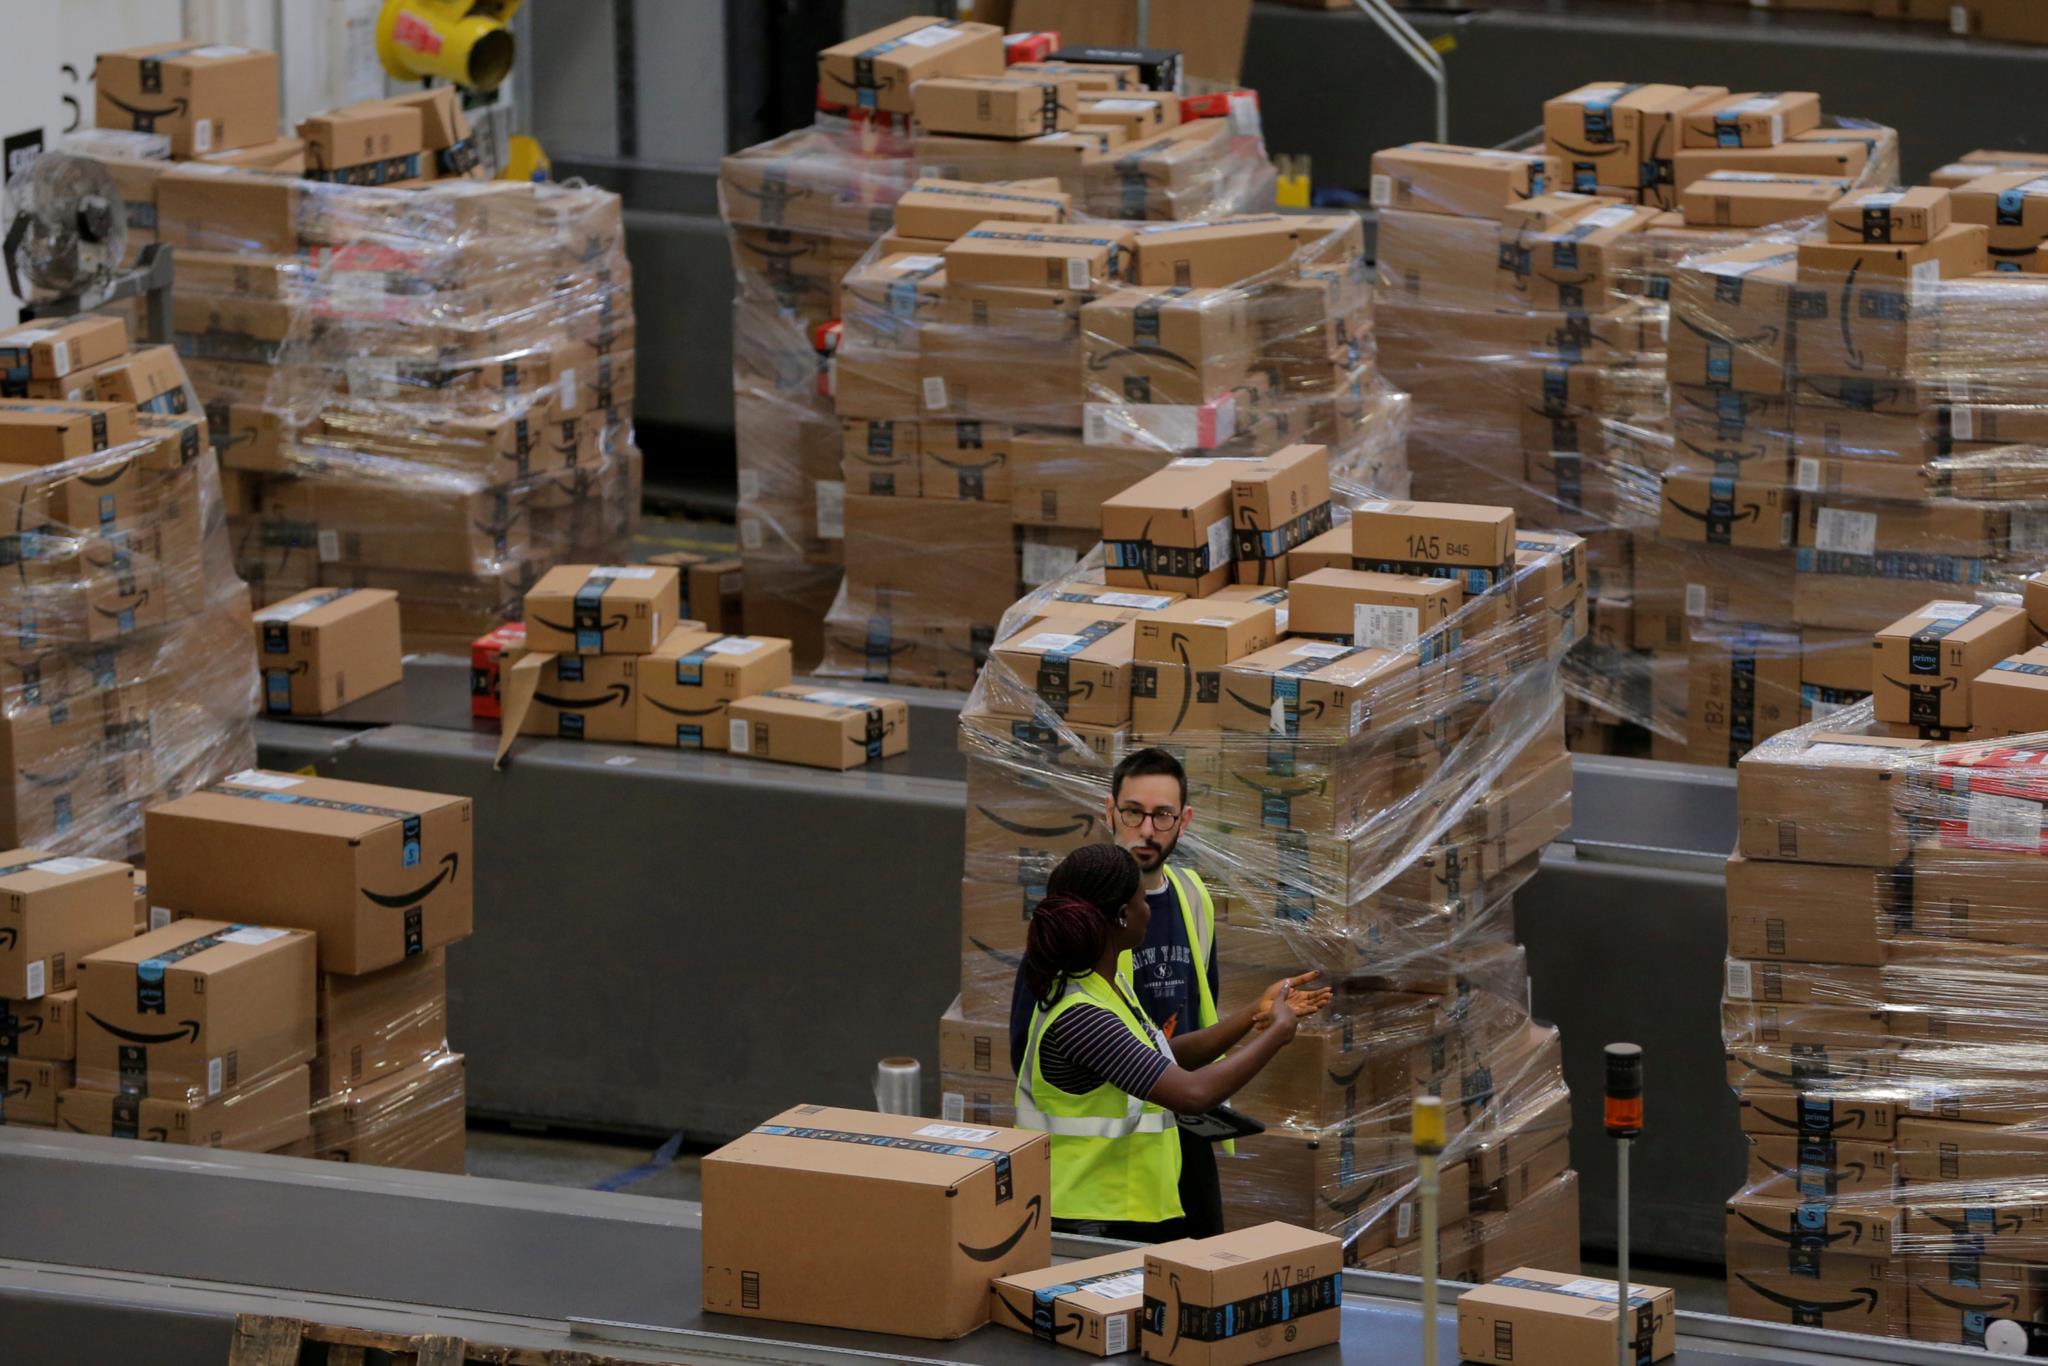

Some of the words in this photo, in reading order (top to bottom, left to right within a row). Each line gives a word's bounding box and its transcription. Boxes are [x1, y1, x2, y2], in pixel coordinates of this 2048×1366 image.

[1406, 536, 1440, 560] 1A5
[1446, 543, 1470, 556] B45
[1912, 653, 1937, 665] prime
[1803, 1111, 1830, 1122] prime
[1262, 1265, 1291, 1292] 1A7
[1296, 1265, 1316, 1283] B47
